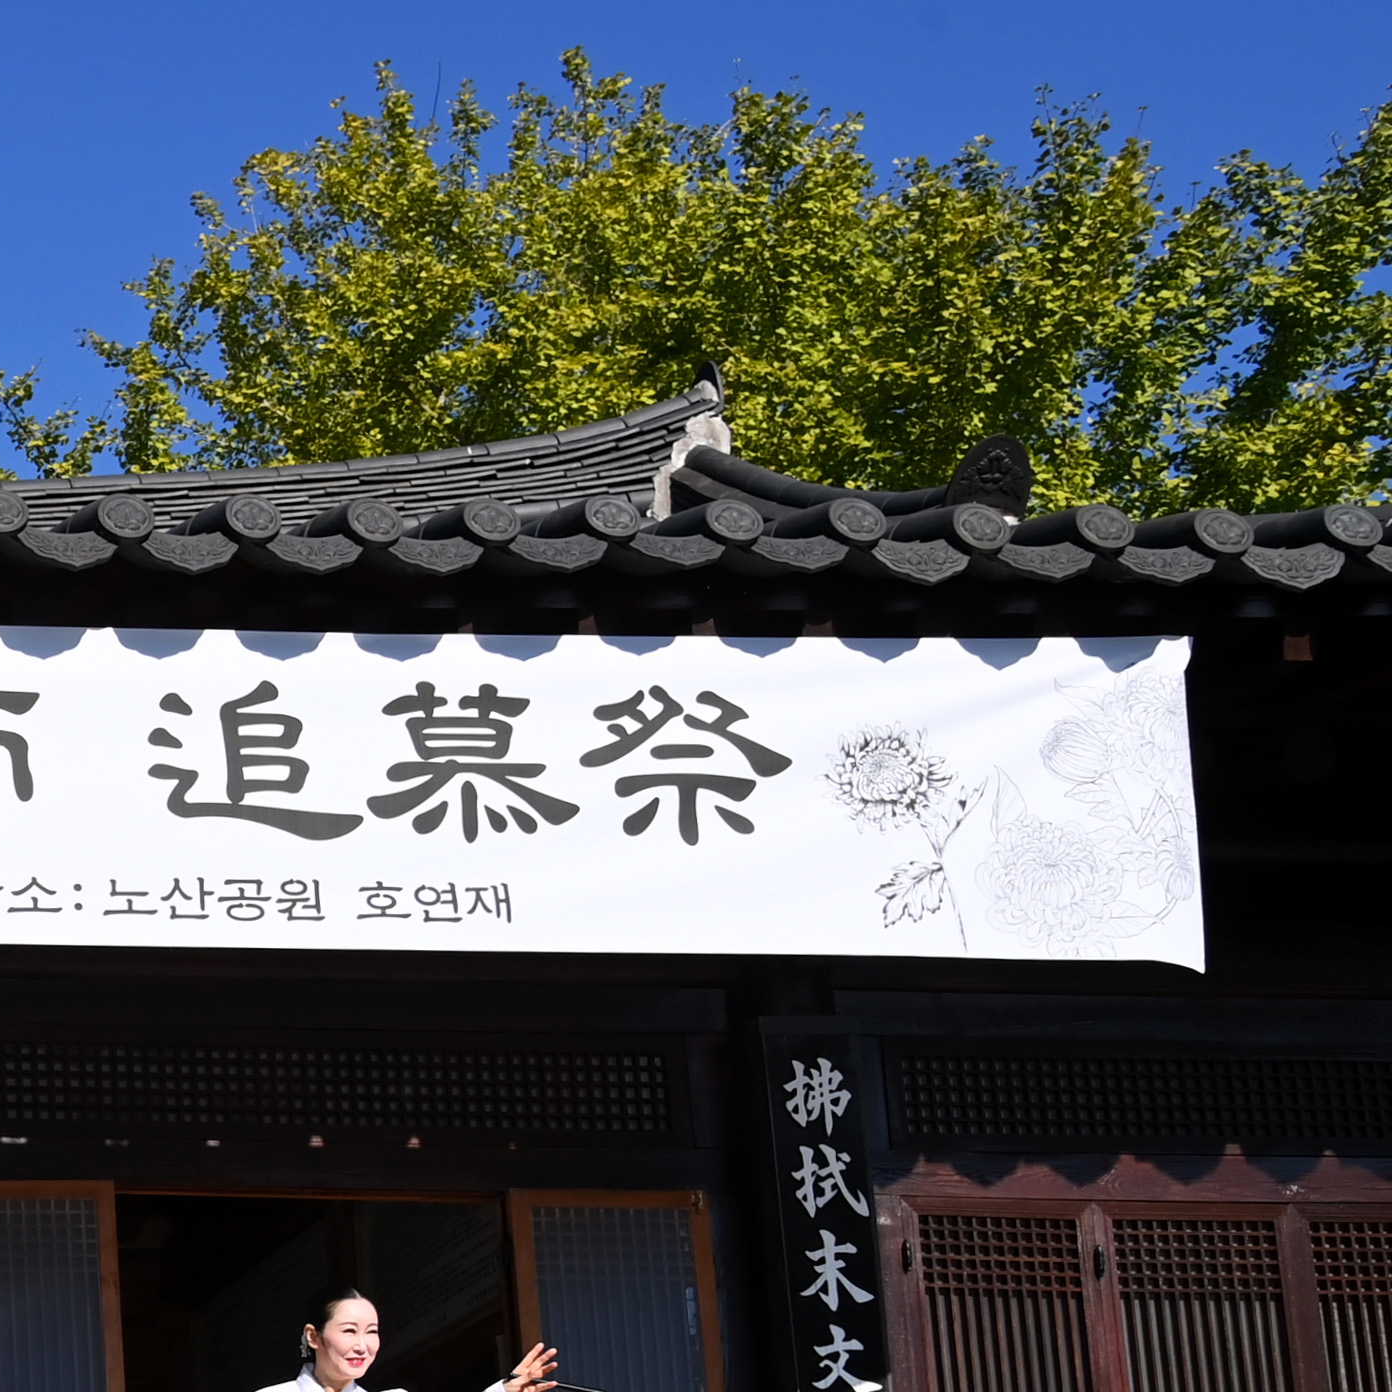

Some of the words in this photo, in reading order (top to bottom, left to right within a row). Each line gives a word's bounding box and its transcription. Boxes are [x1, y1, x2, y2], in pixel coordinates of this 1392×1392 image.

[148, 681, 792, 845] 追慕祭
[358, 882, 511, 923] 호연재
